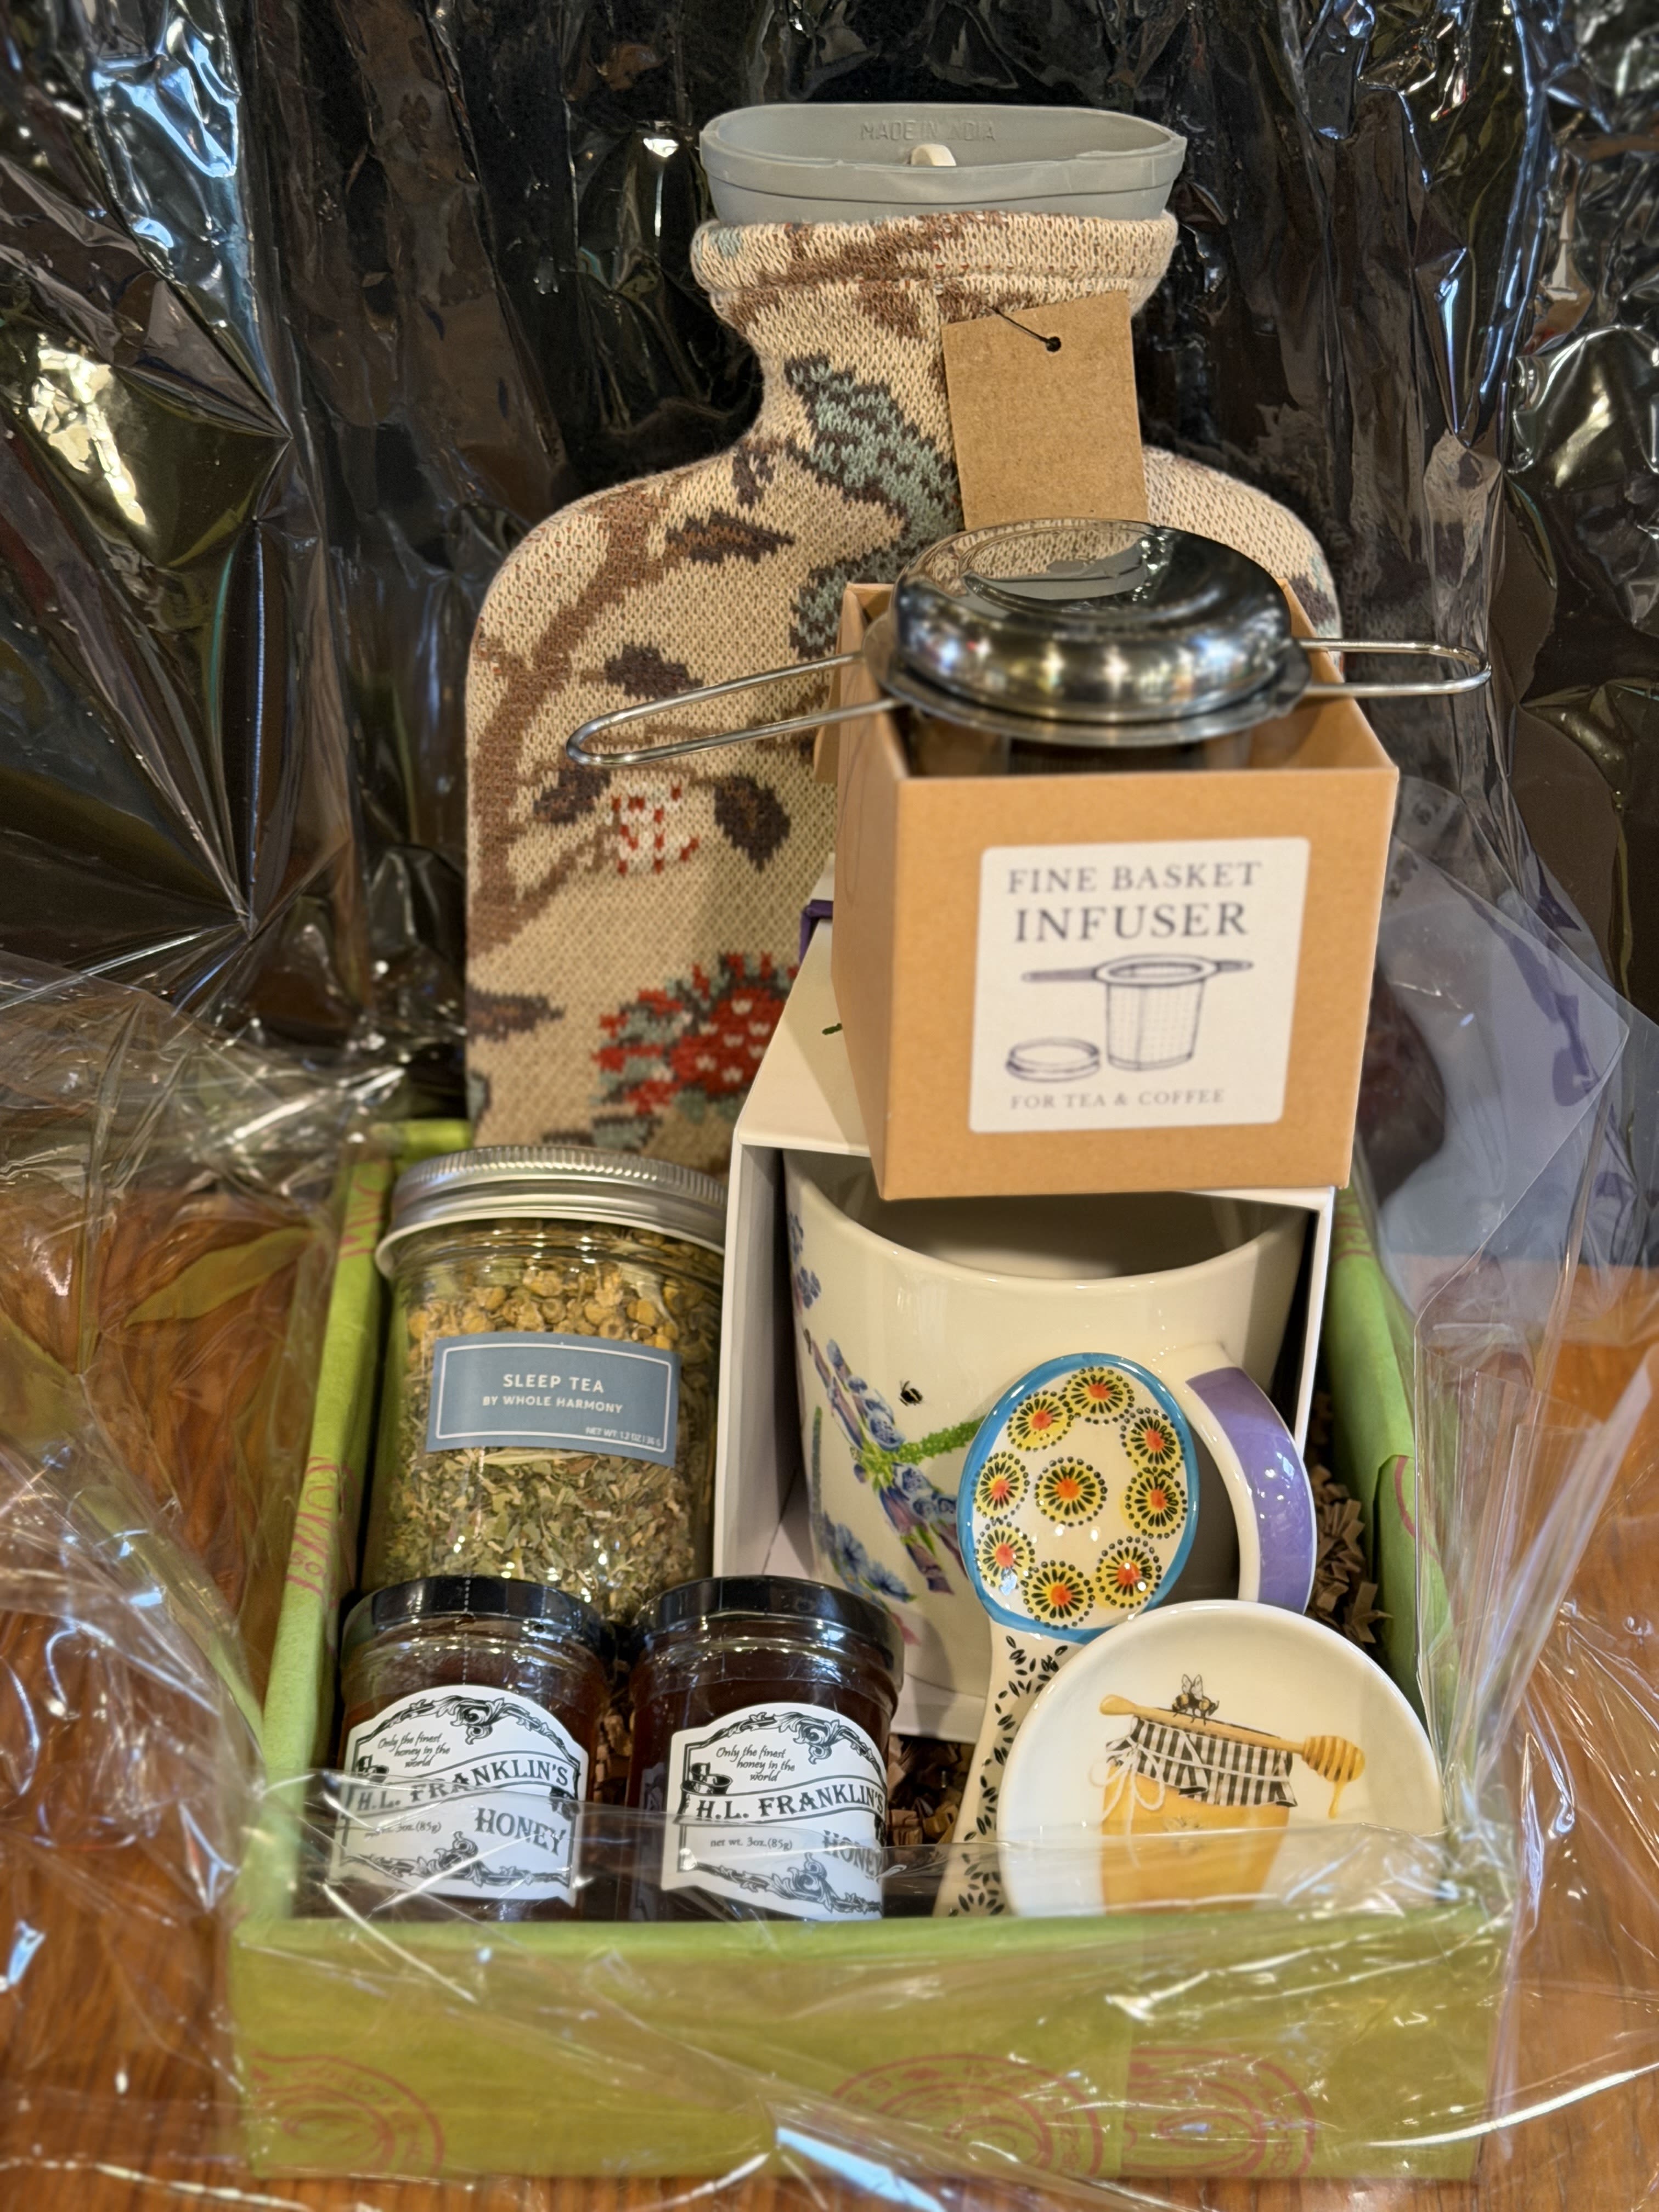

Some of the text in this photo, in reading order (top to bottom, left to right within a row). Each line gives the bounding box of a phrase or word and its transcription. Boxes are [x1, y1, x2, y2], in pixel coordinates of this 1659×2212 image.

[860, 120, 916, 141] MADE
[922, 120, 939, 139] IN
[1007, 861, 1262, 894] FINE BASKET
[1014, 901, 1248, 943] INFUSER
[1011, 1089, 1224, 1110] FOR TEA & COFFEE
[503, 1374, 604, 1393] SLEEP TEA
[482, 1395, 623, 1414] BY WHOLE HARMONY
[377, 1731, 443, 1752] Only the finest
[394, 1742, 450, 1761] honey in the
[404, 1756, 436, 1768] world
[716, 1744, 786, 1762] Only the finest
[737, 1758, 795, 1774] honey in the
[750, 1770, 781, 1781] world
[358, 1759, 568, 1810] H.L. FRANKLIN'S
[696, 1784, 883, 1820] H.L. FRANKLIN'S
[475, 1807, 567, 1857] HONEY
[710, 1838, 725, 1847] net
[728, 1838, 743, 1847] wt.
